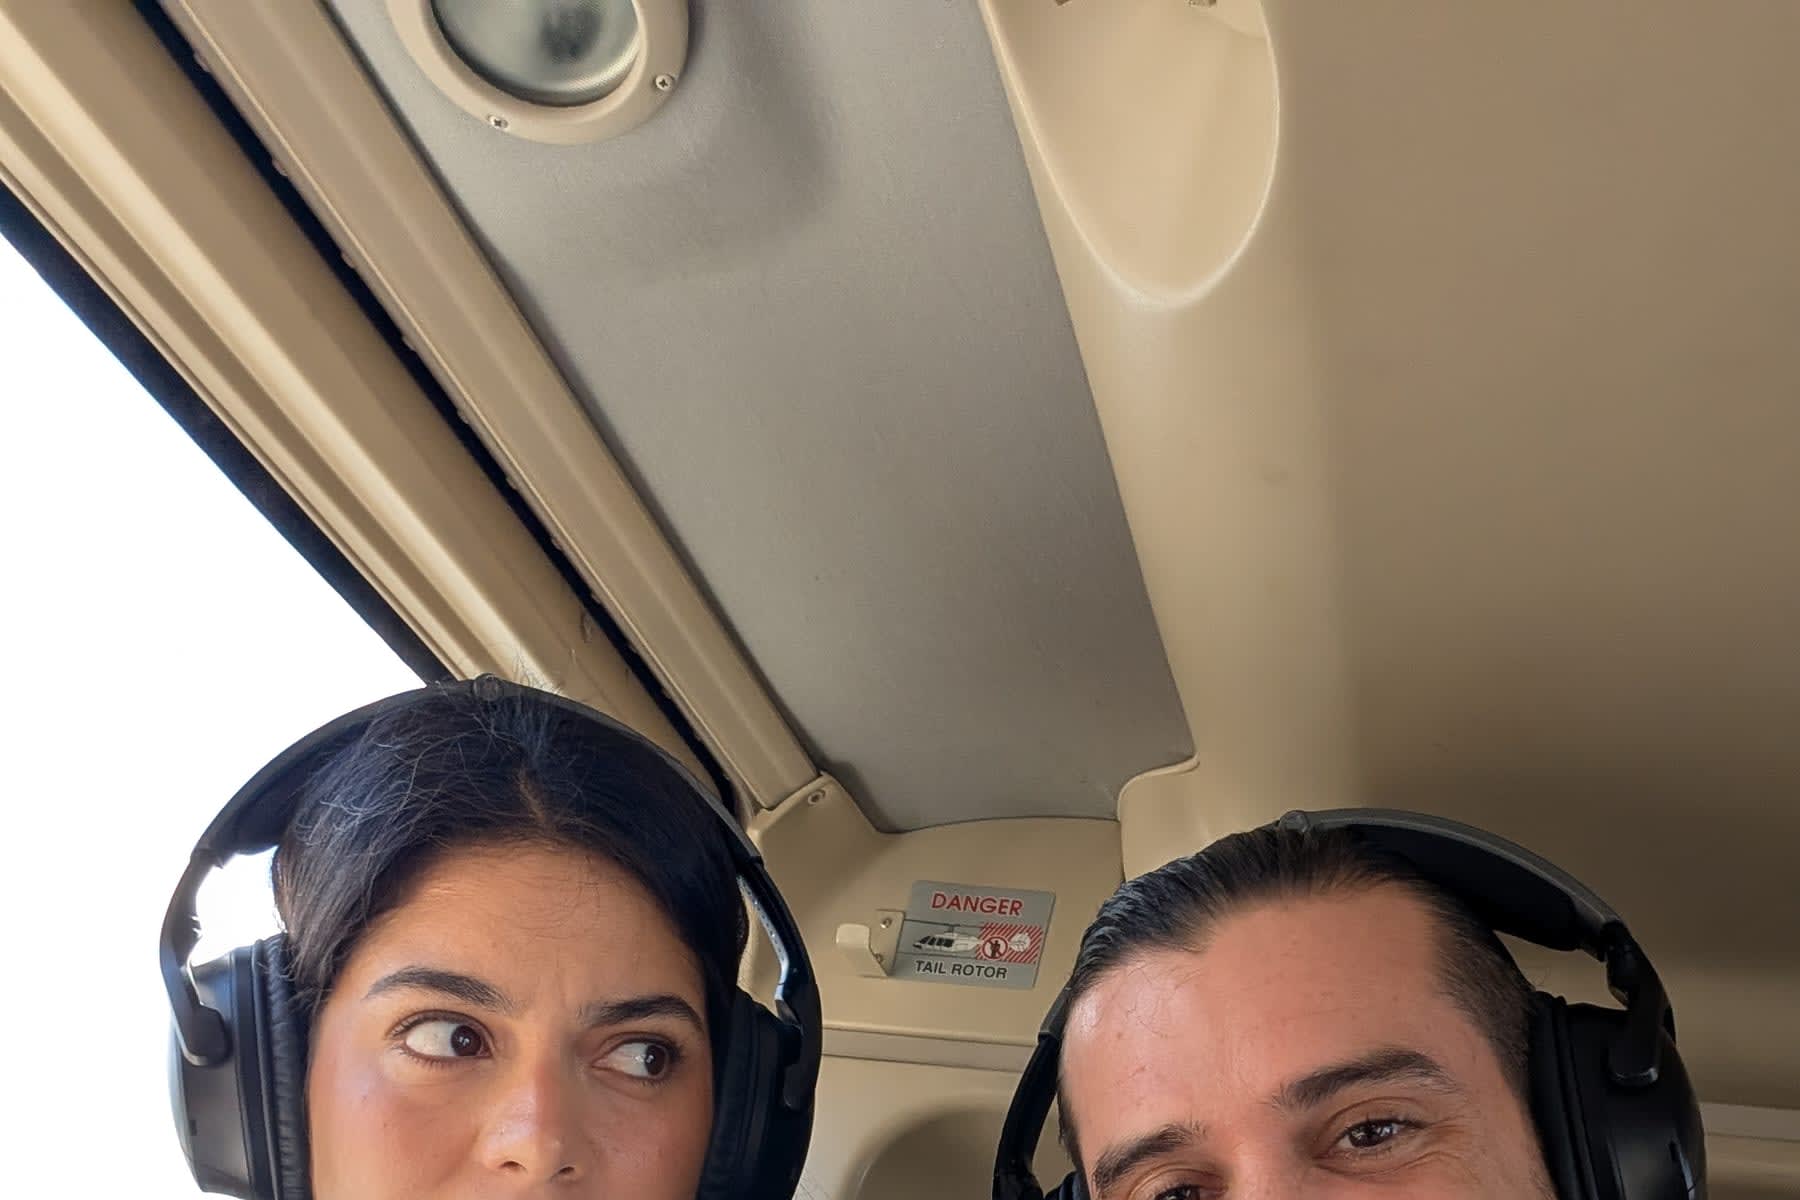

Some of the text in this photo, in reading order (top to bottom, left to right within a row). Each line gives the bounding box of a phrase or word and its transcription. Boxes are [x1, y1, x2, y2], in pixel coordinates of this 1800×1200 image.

[931, 892, 1023, 916] DANGER
[915, 960, 1008, 979] TAIL ROTOR
